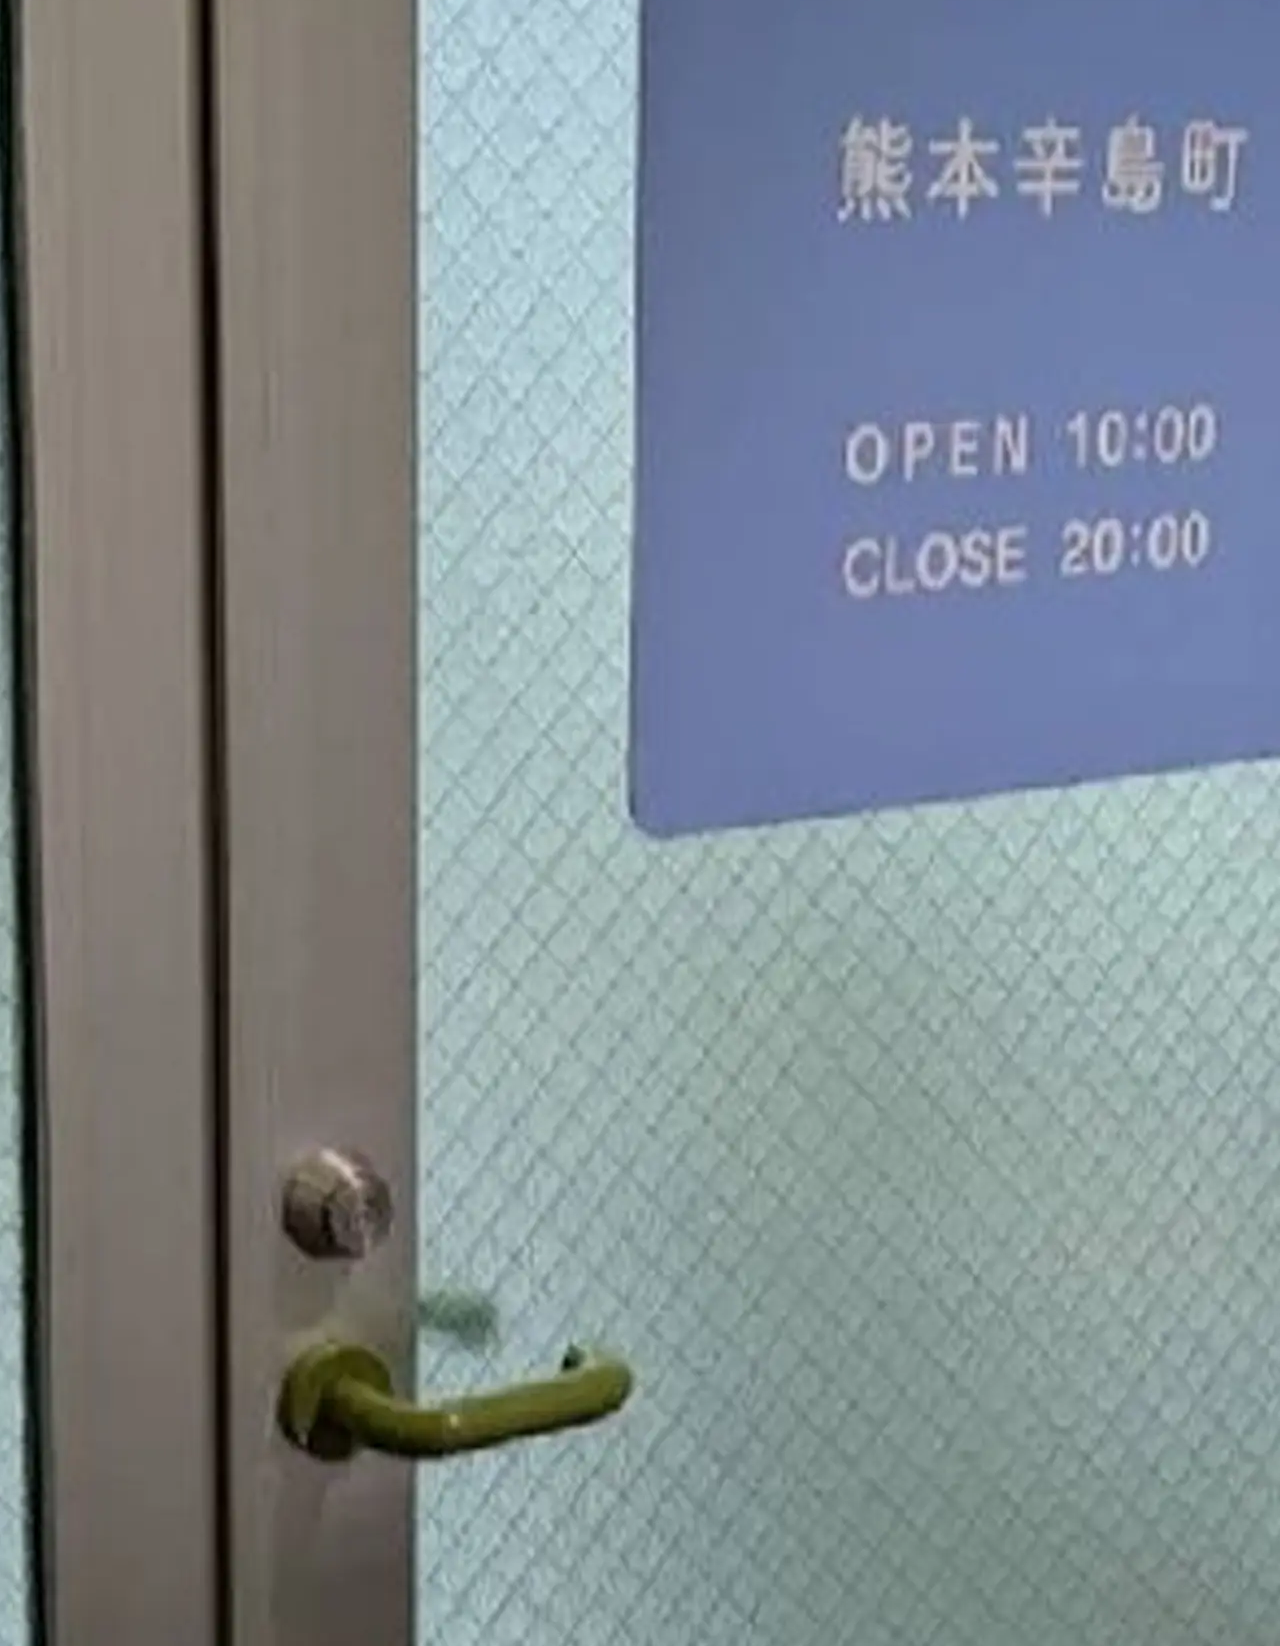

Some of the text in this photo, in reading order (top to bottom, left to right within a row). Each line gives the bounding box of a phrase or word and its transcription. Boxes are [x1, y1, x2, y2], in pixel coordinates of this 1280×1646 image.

[837, 115, 1248, 221] 熊本辛島町
[844, 404, 1217, 484] OPEN 10:00
[842, 511, 1210, 599] CLOSE 20:00
